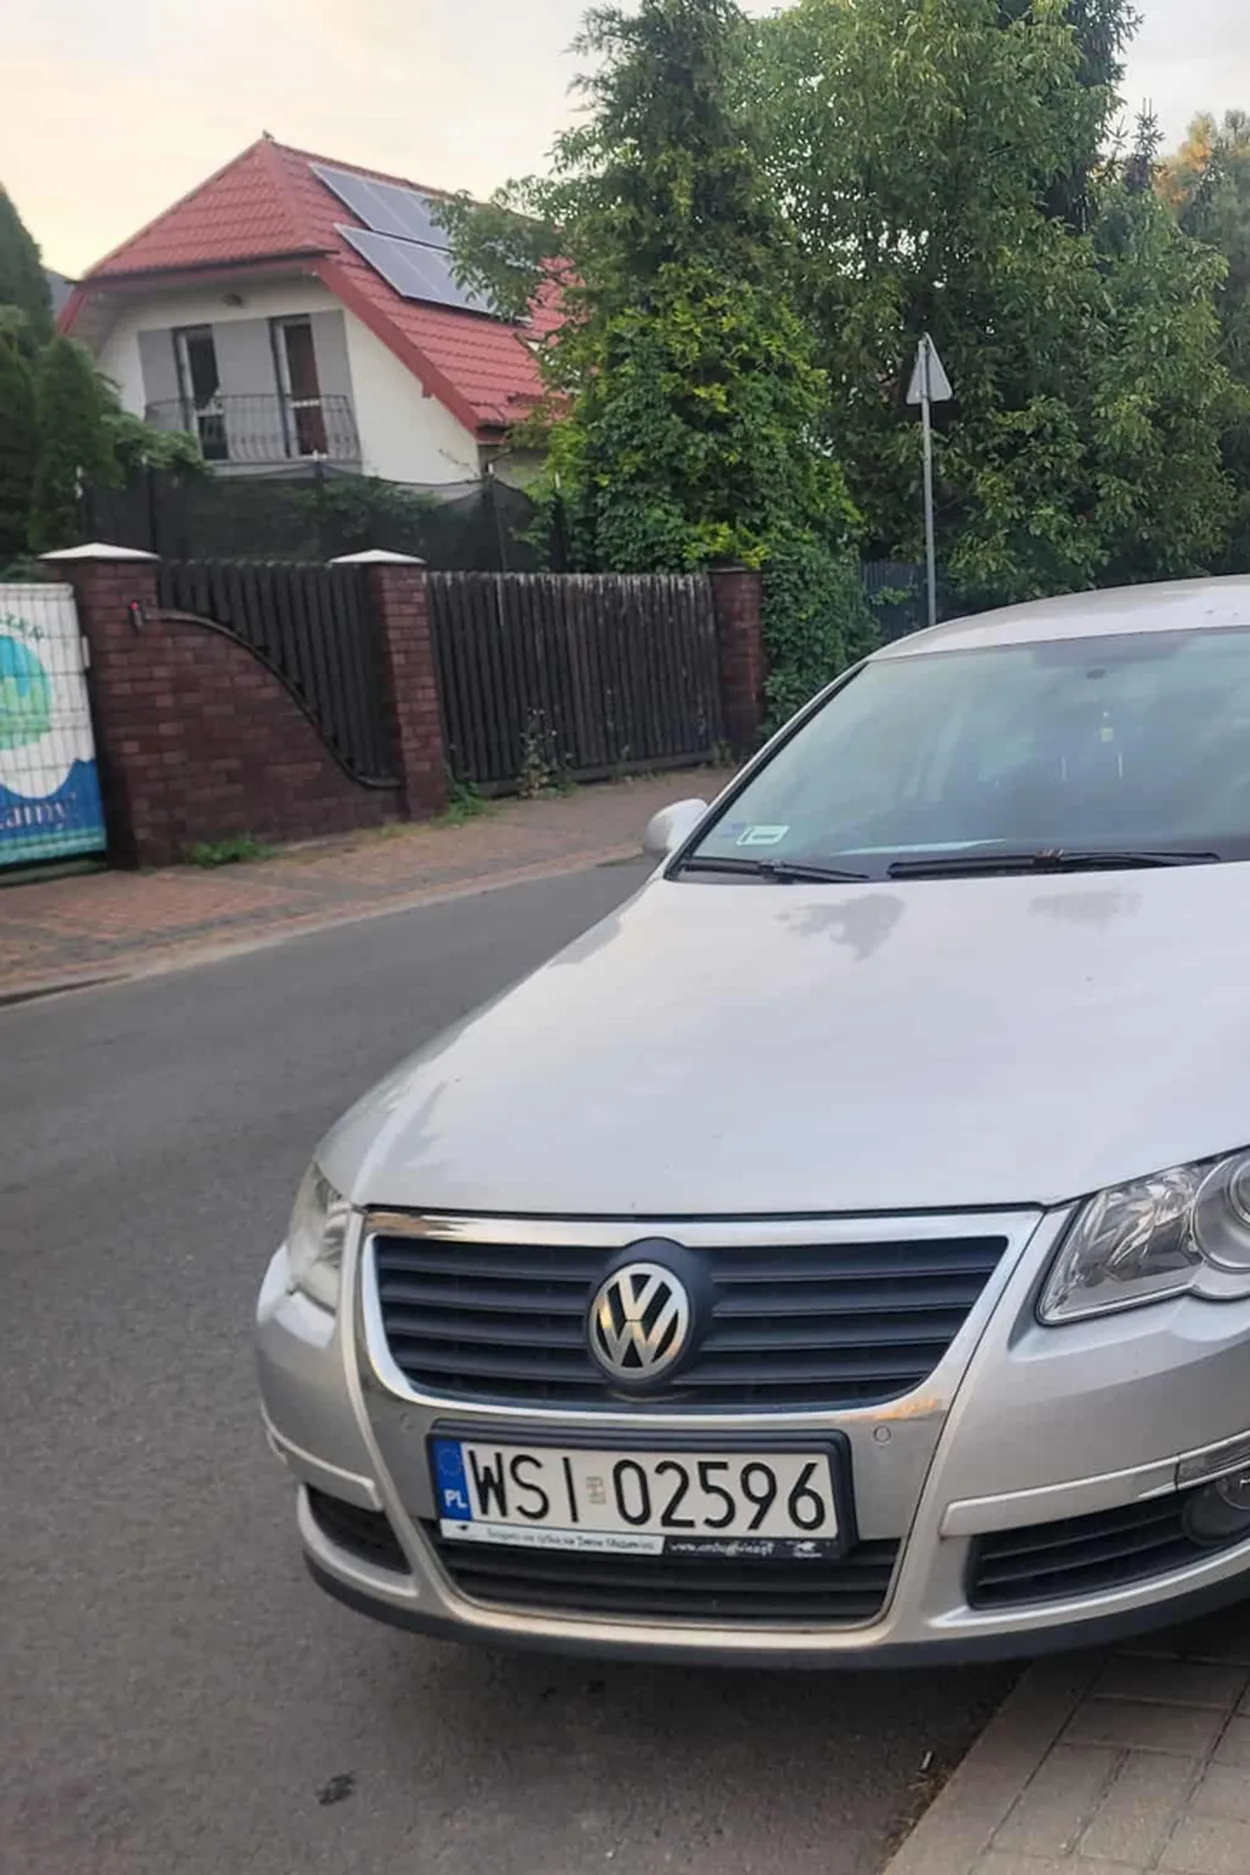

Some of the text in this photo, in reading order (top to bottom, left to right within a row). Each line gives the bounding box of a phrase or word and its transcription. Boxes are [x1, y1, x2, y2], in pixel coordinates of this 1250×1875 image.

[588, 1262, 689, 1379] VW
[443, 1488, 468, 1509] PL
[467, 1449, 826, 1531] WSI 02596
